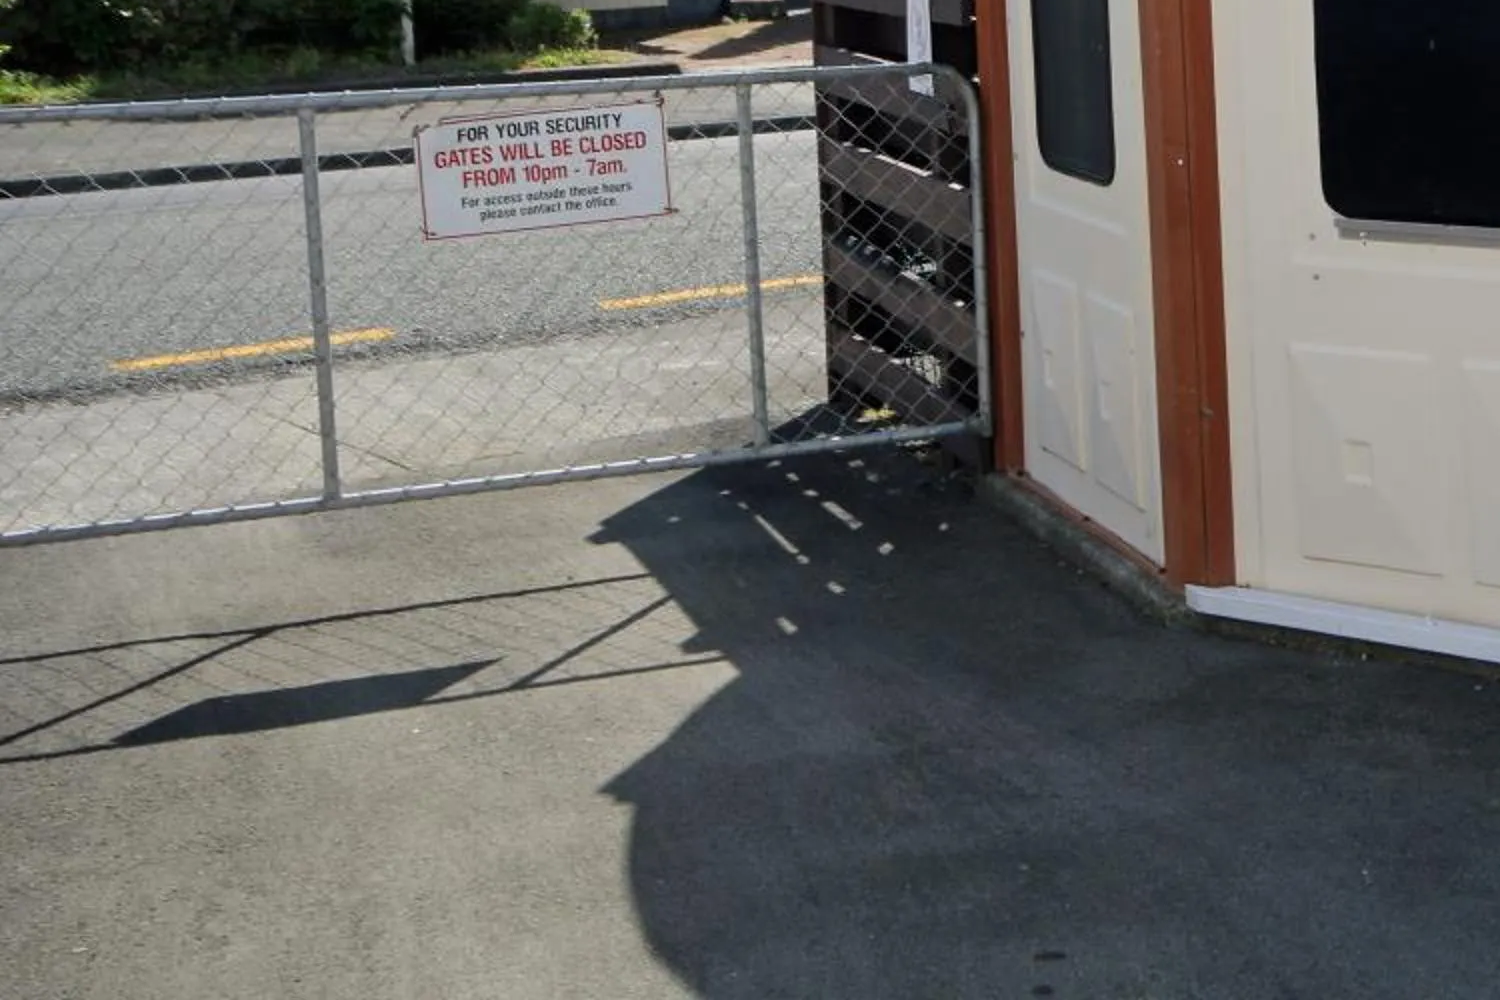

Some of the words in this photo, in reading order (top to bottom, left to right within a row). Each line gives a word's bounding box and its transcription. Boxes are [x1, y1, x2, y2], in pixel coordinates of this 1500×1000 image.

[457, 125, 489, 142] FOR
[496, 120, 540, 139] YOUR
[545, 112, 622, 134] SECURITY
[434, 146, 493, 169] GATES
[499, 142, 544, 162] WILL
[551, 138, 573, 157] BE
[579, 131, 647, 154] CLOSED
[463, 167, 516, 189] FROM
[523, 164, 568, 185] 10pm
[585, 158, 628, 177] 7am.
[461, 197, 480, 209] For
[484, 192, 523, 207] access
[526, 187, 566, 201] outside
[480, 208, 517, 222] please
[565, 200, 582, 211] the
